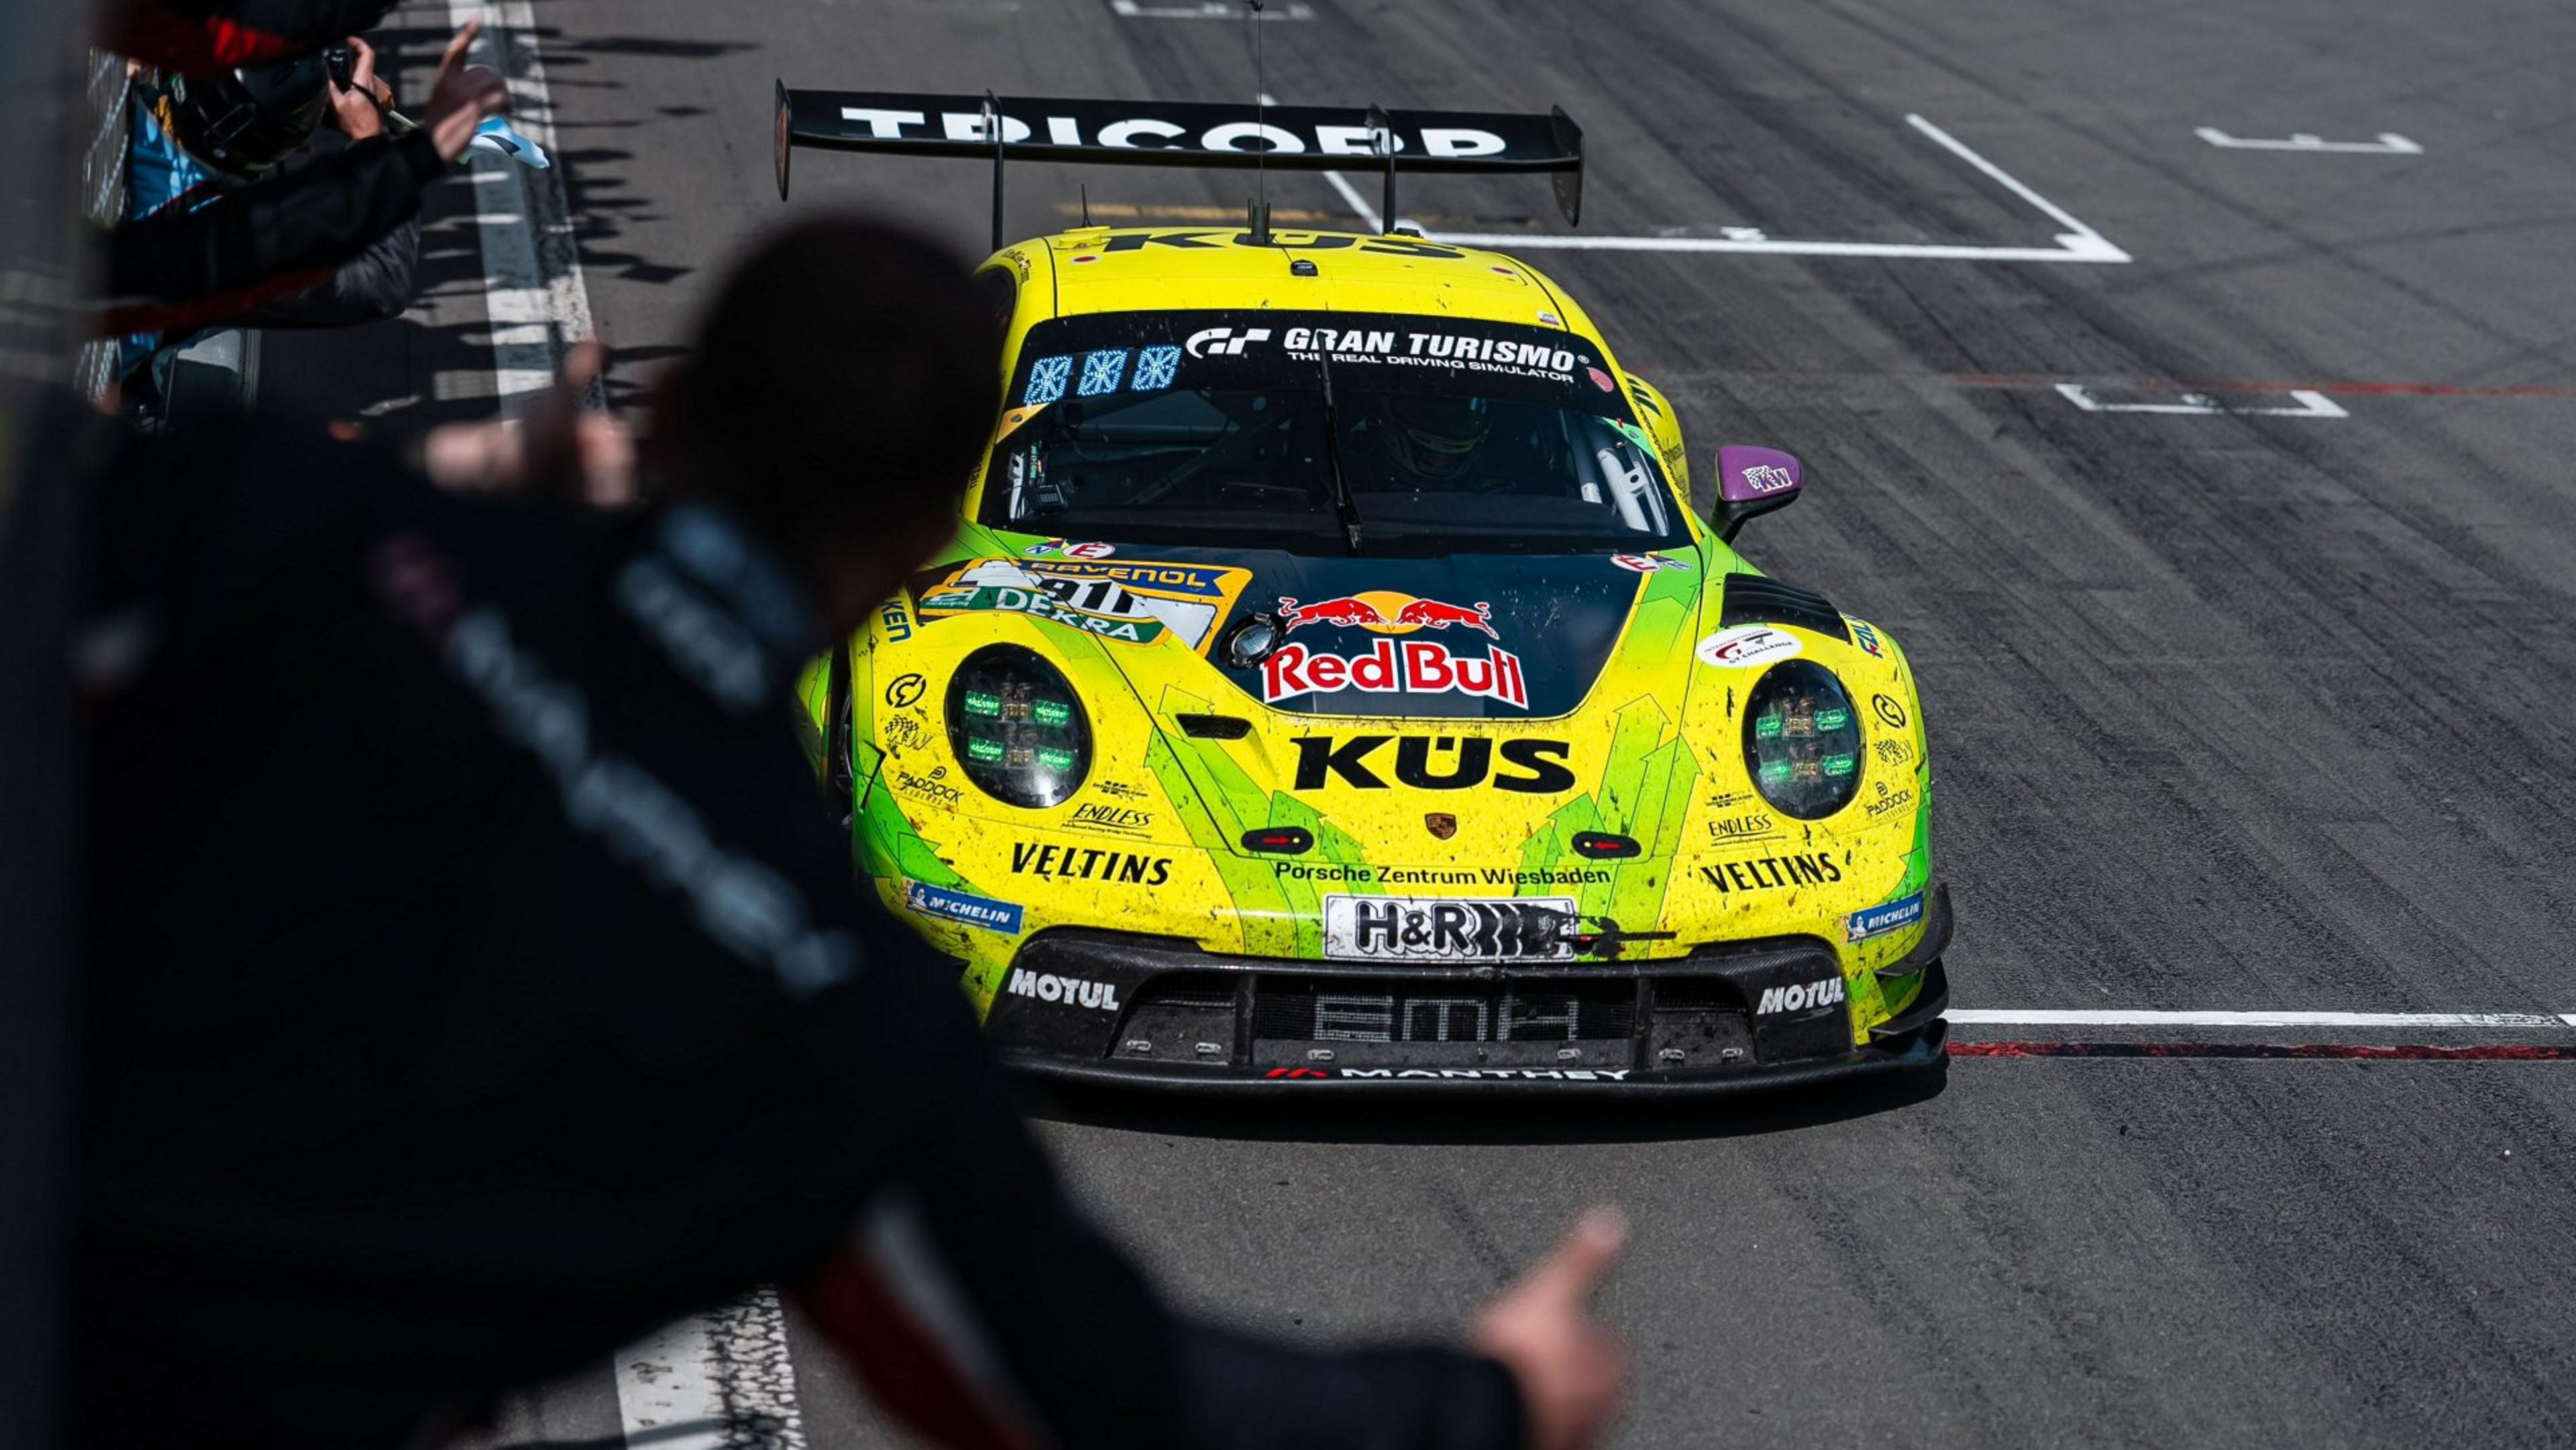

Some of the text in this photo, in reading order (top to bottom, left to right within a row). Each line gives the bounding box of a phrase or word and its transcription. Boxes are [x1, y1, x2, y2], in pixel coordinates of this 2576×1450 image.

[1283, 327, 1395, 353] GRAN
[1332, 353, 1382, 364] REAL
[1387, 356, 1465, 370] DRIVING
[1468, 361, 1574, 384] SIMULATOR
[1030, 561, 1207, 588] RAVENOL
[995, 588, 1140, 642] DEKRA
[1263, 638, 1529, 710] Red Bull
[1290, 735, 1576, 794] KÜS
[896, 771, 965, 804] PADDOCK
[1073, 802, 1156, 826] ENDLESS
[1866, 789, 1914, 818] PADDOCK
[1708, 812, 1772, 836] ENDLESS
[1010, 841, 1173, 887] VELTINS
[1276, 862, 1611, 885] Porsche Zentrum Wiesbaden
[1701, 851, 1842, 894] VELTINS
[928, 897, 1011, 924] MICHELIN
[1868, 901, 1921, 930] MICHELIN
[1355, 901, 1476, 956] H&R
[1008, 967, 1120, 1011] MOTUL
[1756, 977, 1845, 1015] MOTUL
[1341, 1068, 1631, 1080] MANTHEY
